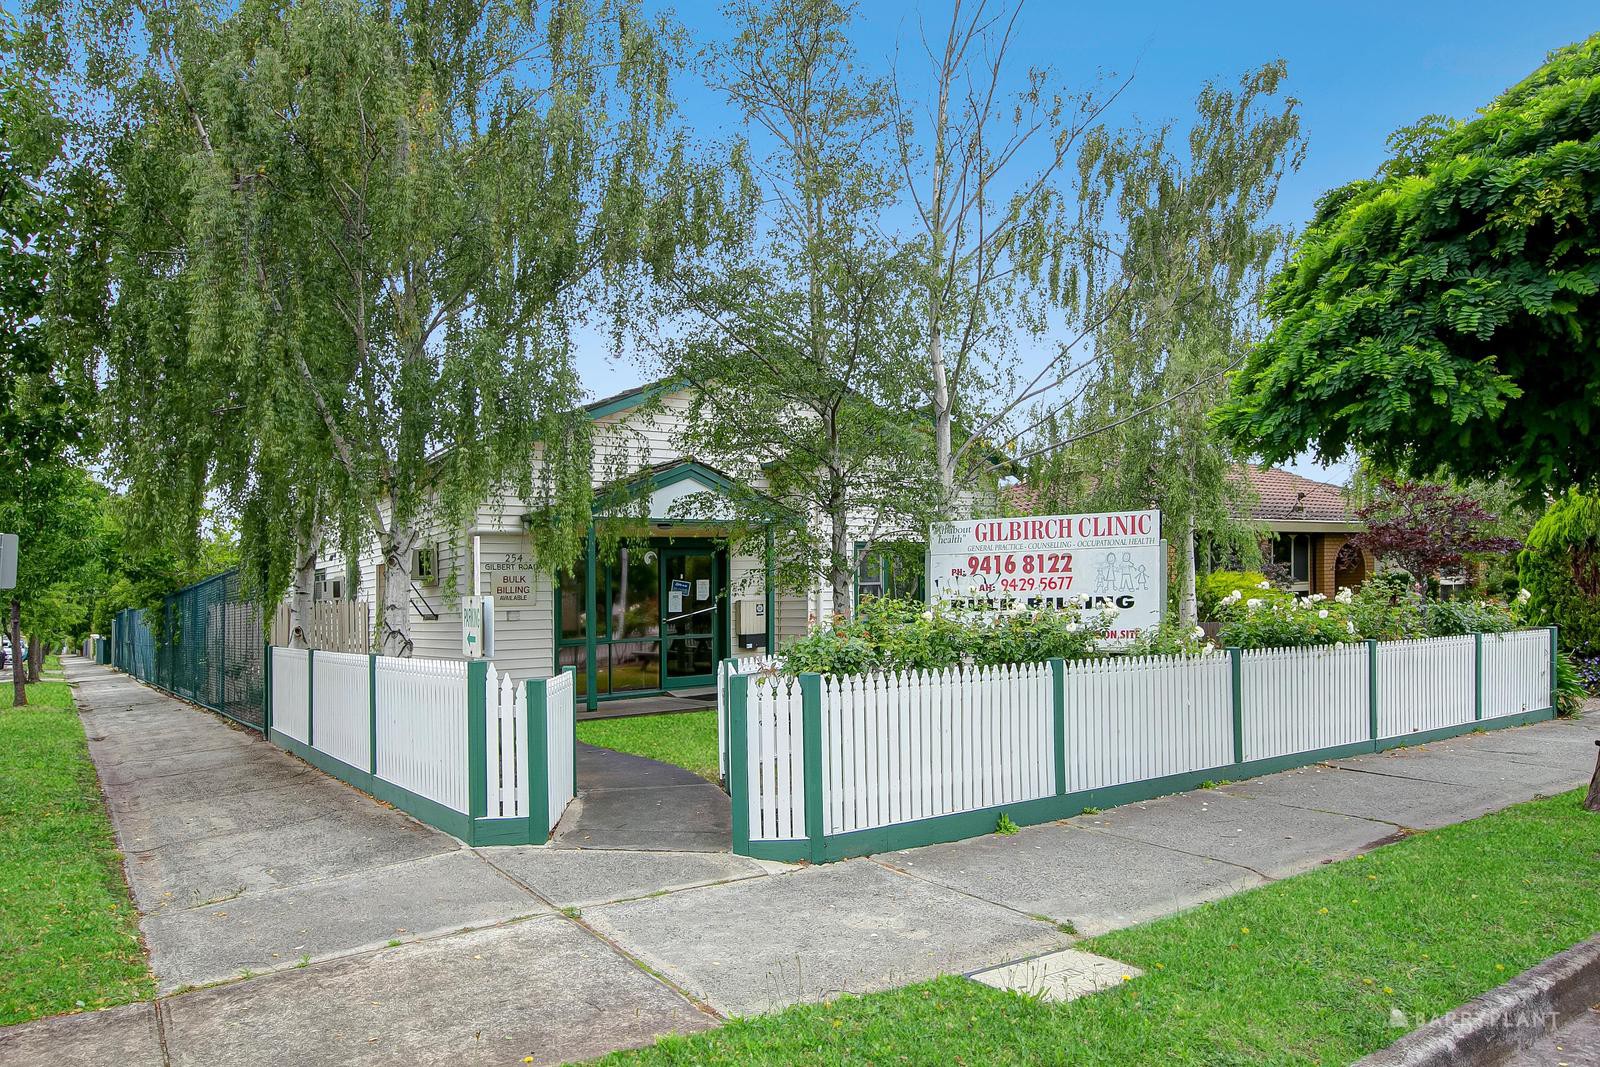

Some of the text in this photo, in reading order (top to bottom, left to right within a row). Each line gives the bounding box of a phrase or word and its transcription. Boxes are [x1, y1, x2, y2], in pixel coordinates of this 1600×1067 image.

[975, 514, 1152, 543] GILBIRCH CLINIC
[994, 543, 1024, 551] PRACTICE
[1028, 541, 1072, 550] COUNSELLING
[1077, 539, 1127, 547] OCCUPATIONAL
[1128, 537, 1155, 545] HEALTH
[505, 553, 523, 563] 254
[485, 563, 515, 571] GILBERT
[951, 553, 1073, 577] PH: 9416 8122
[503, 575, 527, 584] BULK
[979, 576, 1073, 592] AH: 9429 5677
[496, 586, 530, 594] BILLING
